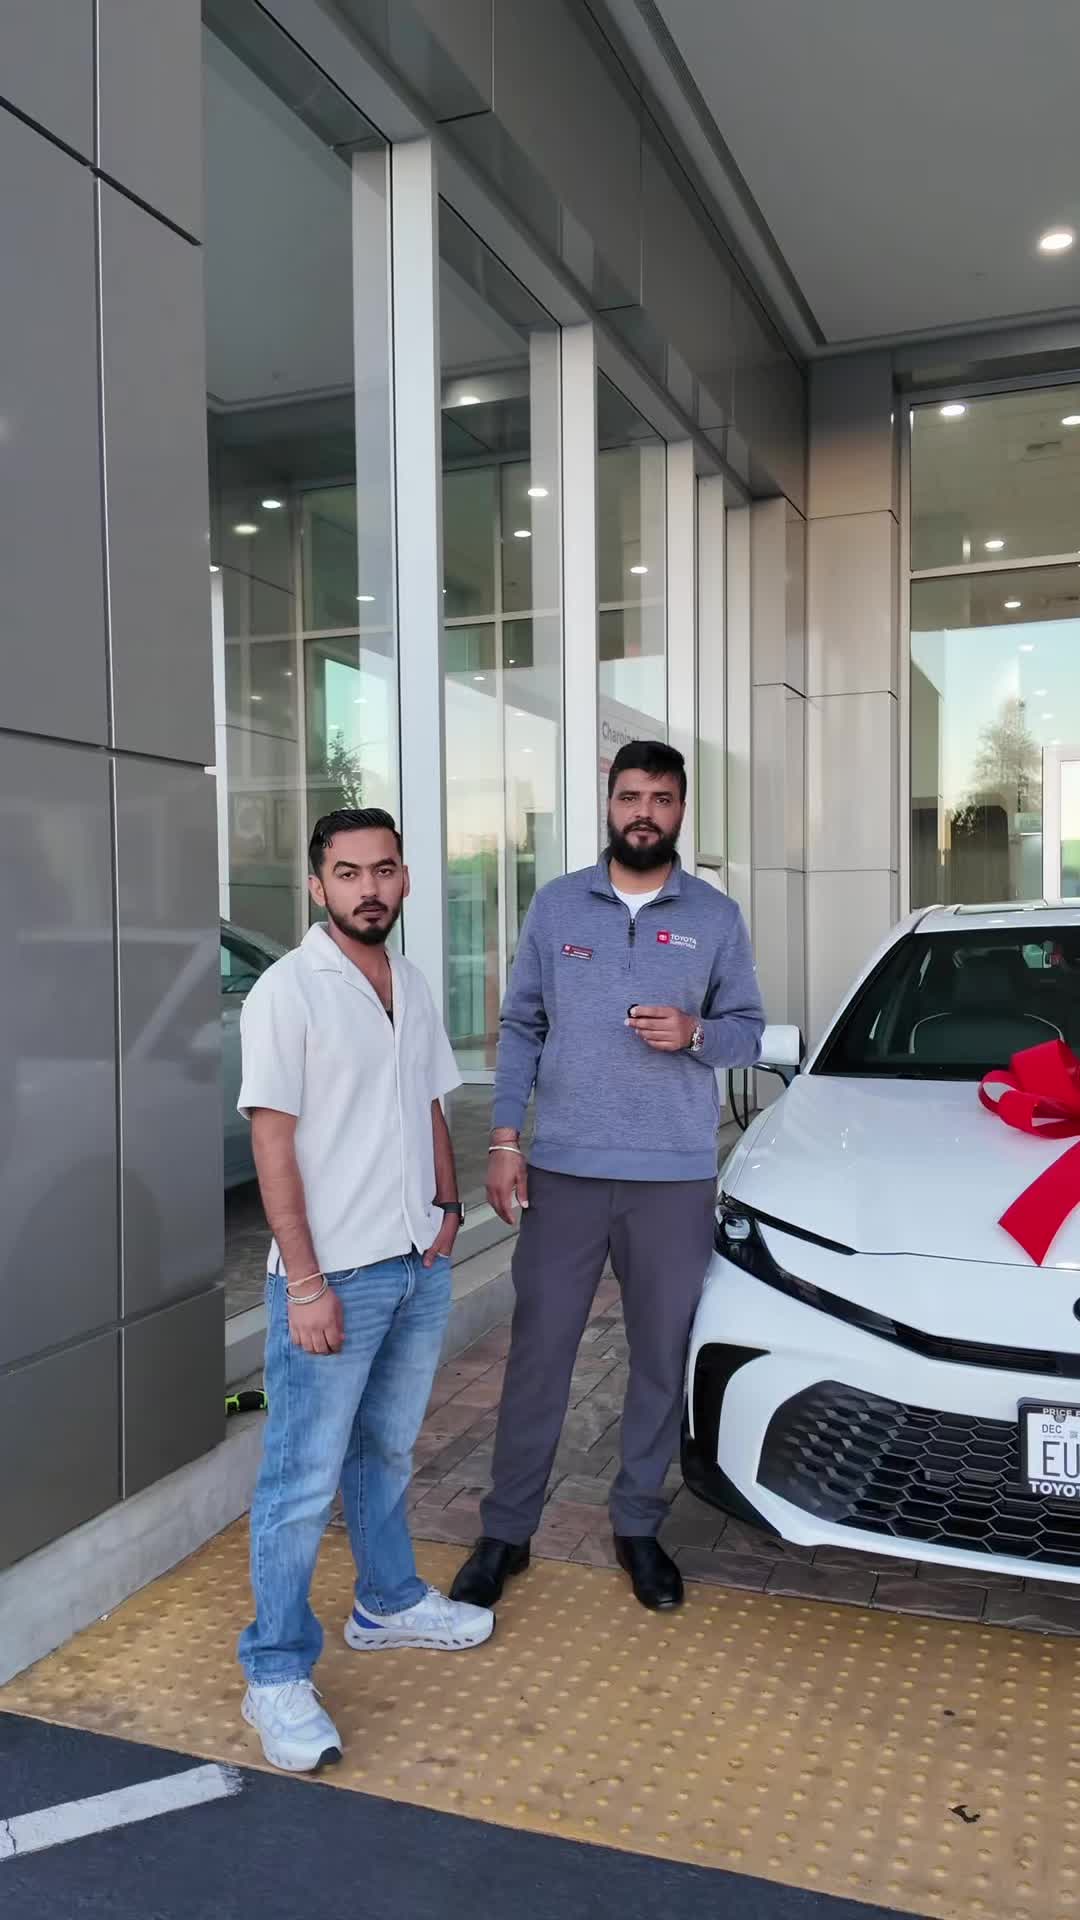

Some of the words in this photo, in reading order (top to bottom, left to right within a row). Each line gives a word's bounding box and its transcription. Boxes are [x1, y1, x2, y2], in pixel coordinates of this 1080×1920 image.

[670, 934, 697, 945] TOYOTA
[1042, 1408, 1072, 1417] PRICE
[1042, 1424, 1062, 1434] DEC
[1043, 1441, 1080, 1478] EU
